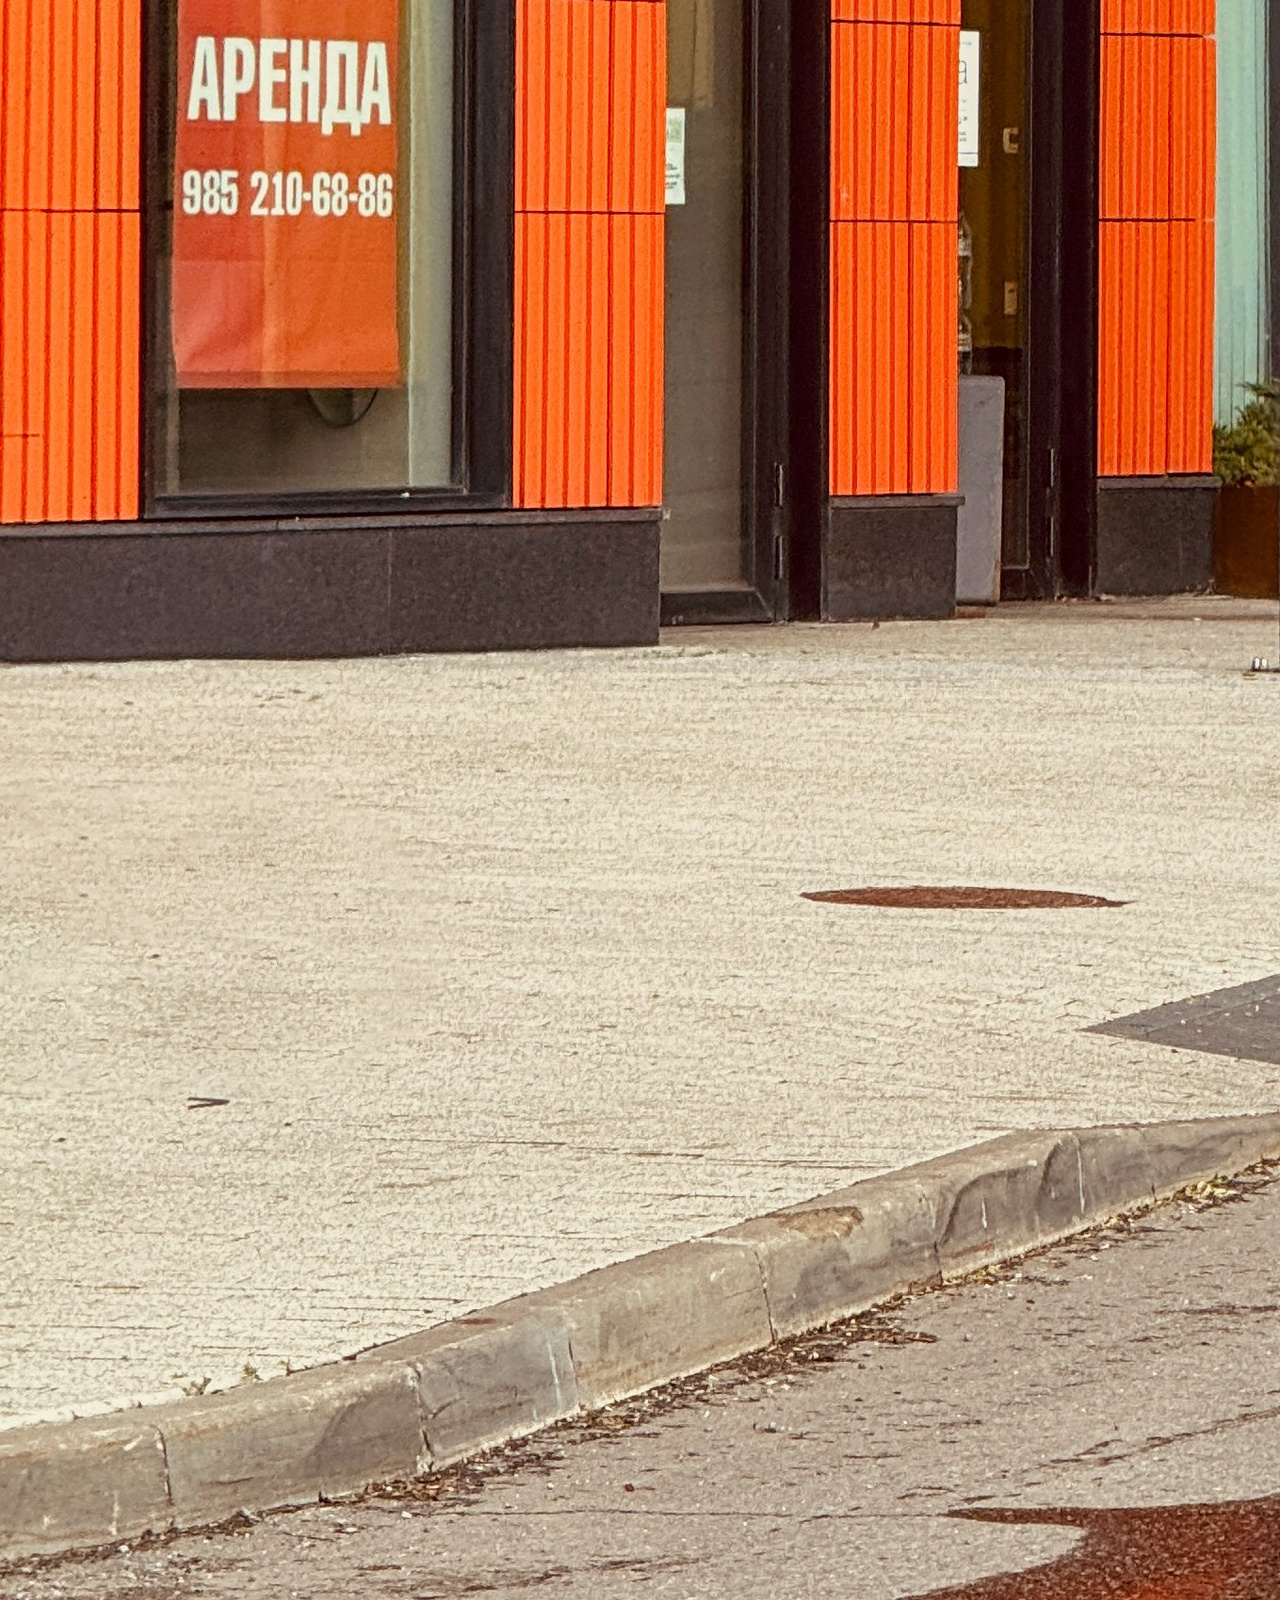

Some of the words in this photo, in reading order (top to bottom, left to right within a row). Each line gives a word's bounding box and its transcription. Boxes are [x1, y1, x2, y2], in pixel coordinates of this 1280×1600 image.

[187, 35, 392, 135] АРЕНДА
[181, 169, 239, 216] 985
[250, 170, 393, 218] 210-68-86
